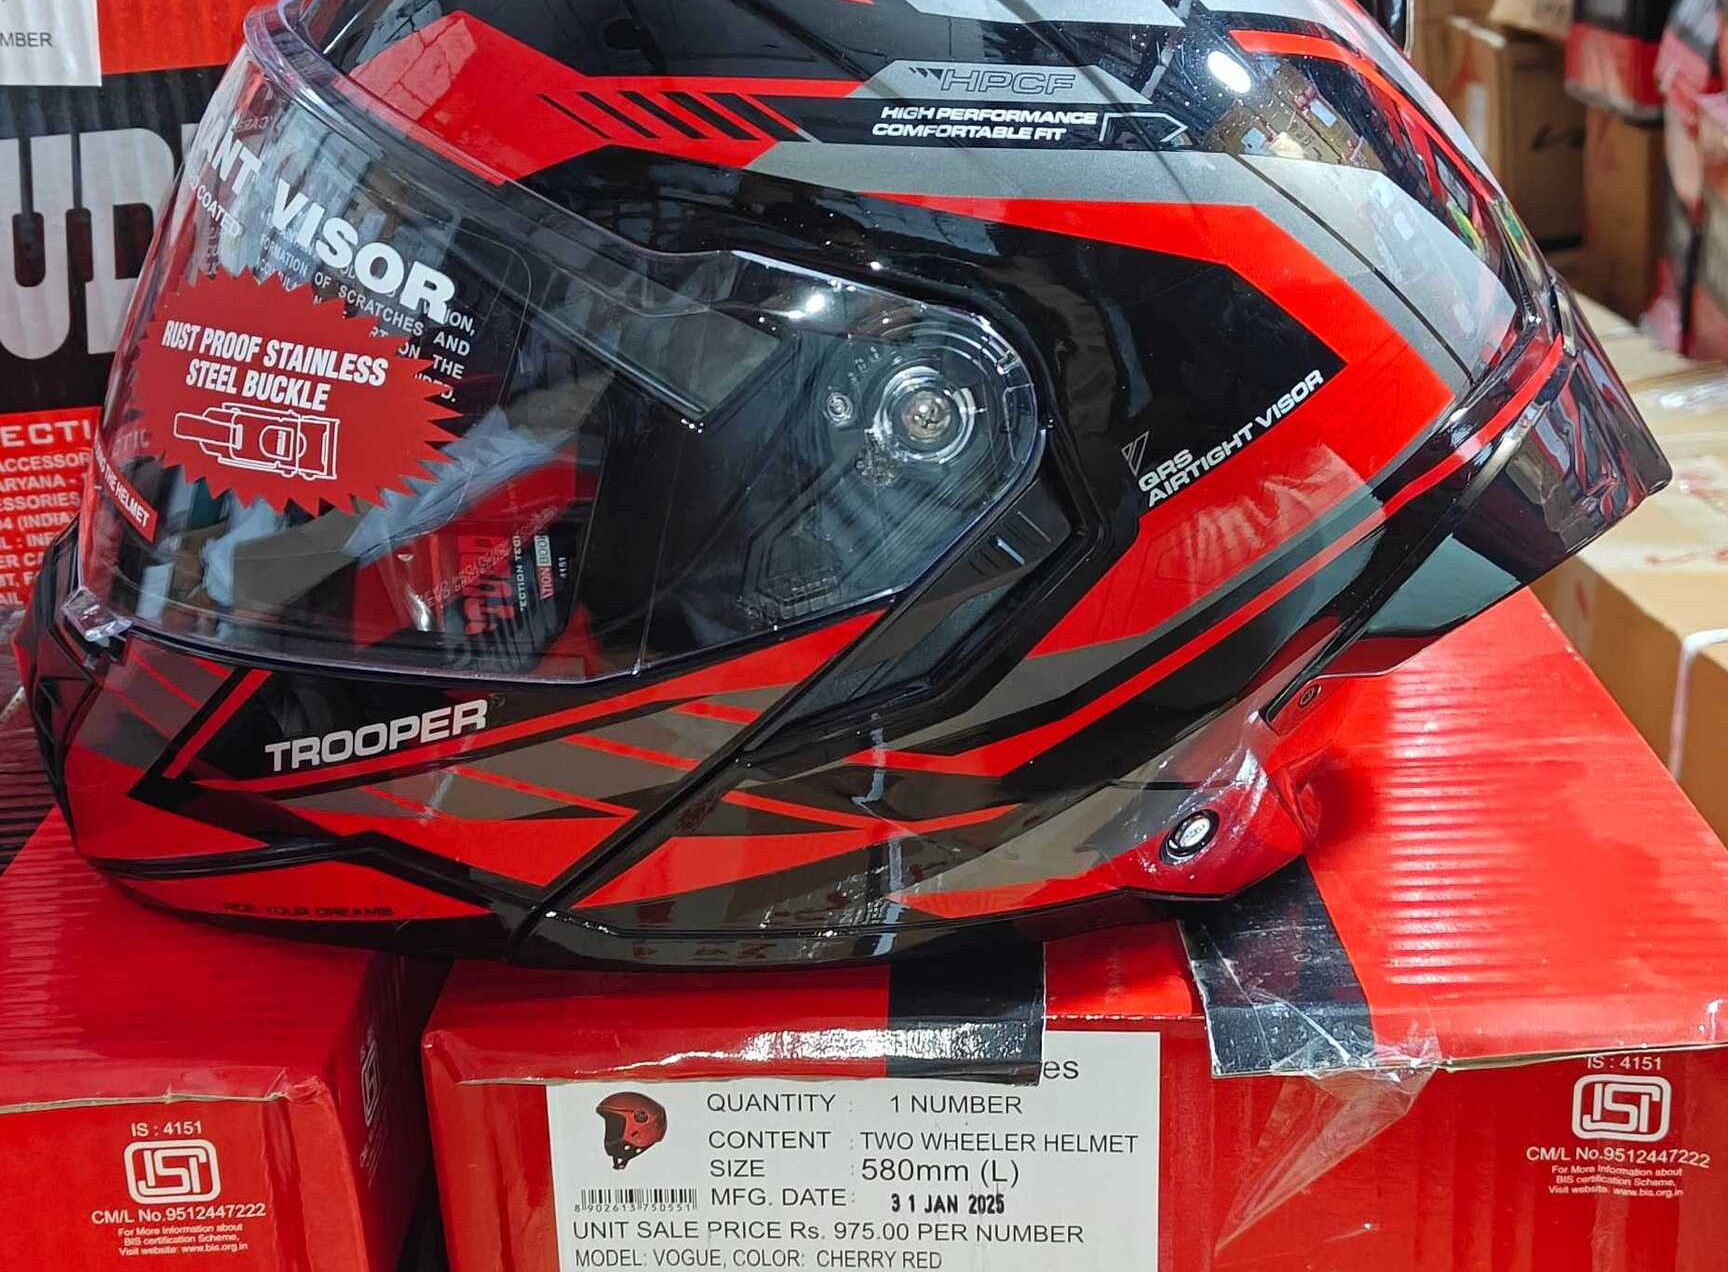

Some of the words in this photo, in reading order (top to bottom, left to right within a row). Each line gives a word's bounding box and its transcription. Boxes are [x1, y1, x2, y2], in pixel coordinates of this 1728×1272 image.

[941, 67, 1076, 95] HPCF
[881, 106, 935, 120] HIGH
[935, 107, 1099, 125] PERFORMANCE
[872, 123, 1035, 140] COMFORTABLE
[1034, 127, 1067, 141] FIT
[196, 185, 244, 237] COATED
[271, 178, 456, 326] VISOR
[315, 272, 331, 289] OF
[338, 285, 424, 337] SCRATCHES
[433, 332, 471, 357] AND
[162, 320, 200, 351] RUST
[199, 327, 262, 363] PROOF
[263, 339, 389, 387] STAINLESS
[432, 354, 465, 380] THE
[186, 358, 238, 394] STEEL
[242, 369, 331, 412] BUCKLE
[1149, 422, 1253, 508] AIRTIGHT
[1255, 369, 1325, 428] VISOR
[1138, 449, 1194, 492] QRS
[115, 481, 150, 528] HELMET
[265, 699, 488, 773] TROOPER
[1587, 1056, 1605, 1069] IS
[1619, 1056, 1661, 1071] 4151
[707, 1093, 836, 1112] QUANTITY
[890, 1095, 899, 1113] 1
[911, 1094, 1023, 1114] NUMBER
[131, 1122, 149, 1137] IS
[163, 1120, 202, 1135] 4151
[708, 1130, 832, 1149] CONTENT
[859, 1131, 914, 1150] TWO
[920, 1132, 1036, 1152] WHEELER
[1044, 1133, 1139, 1153] HELMET
[1526, 1146, 1571, 1161] CM/L
[1576, 1146, 1711, 1169] No.9512447222
[710, 1159, 765, 1178] SIZE
[861, 1158, 969, 1182] 580mm
[980, 1159, 1019, 1187] (L)
[91, 1209, 135, 1224] CM/L
[138, 1203, 267, 1222] No.9512447222
[711, 1187, 773, 1206] MFG.
[924, 1194, 958, 1214] JAN
[968, 1192, 1005, 1215] 2025
[573, 1221, 630, 1240] UNIT
[637, 1220, 699, 1239] SALE
[707, 1221, 782, 1239] PRICE
[790, 1221, 825, 1240] Rs.
[834, 1221, 909, 1241] 975.00
[918, 1223, 968, 1242] PER
[976, 1224, 1084, 1243] NUMBER
[575, 1249, 647, 1267] MODEL:
[652, 1248, 727, 1268] VOGUE,
[732, 1249, 805, 1267] COLOR:
[816, 1249, 897, 1268] CHERRY
[902, 1251, 942, 1269] RED
